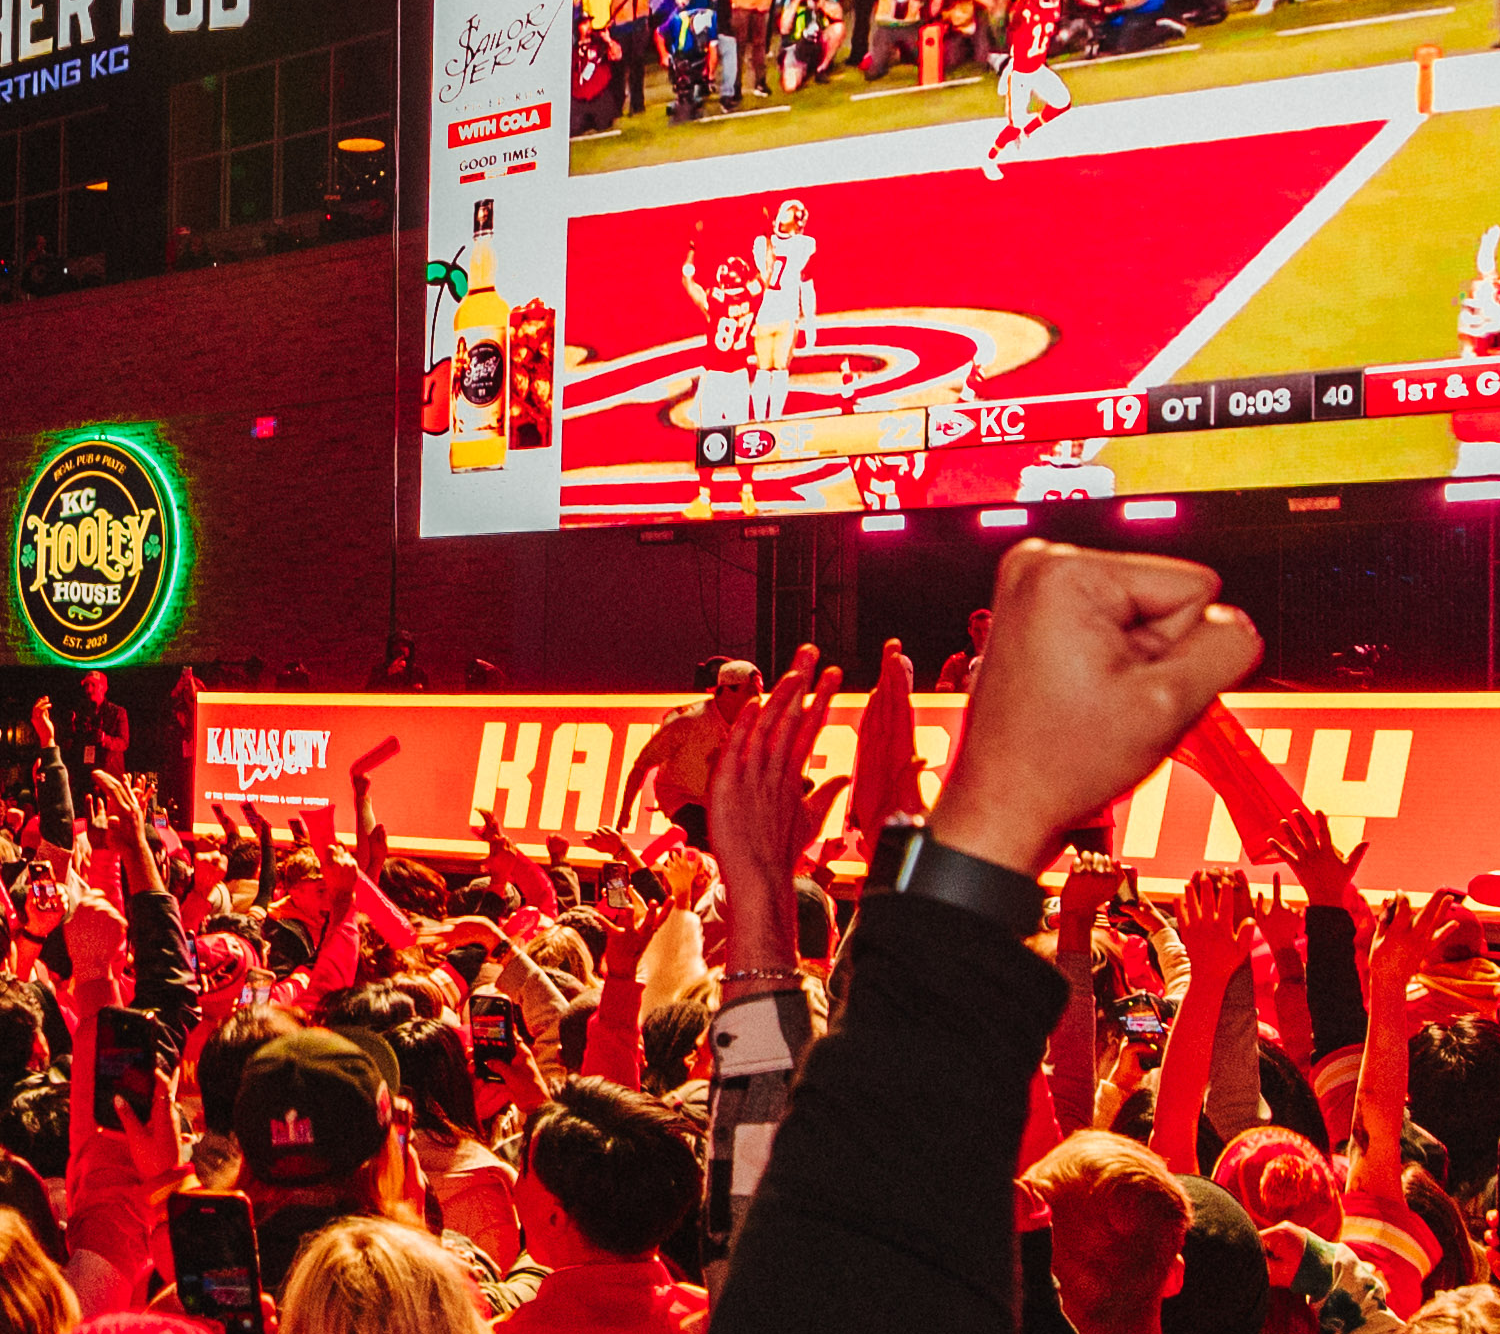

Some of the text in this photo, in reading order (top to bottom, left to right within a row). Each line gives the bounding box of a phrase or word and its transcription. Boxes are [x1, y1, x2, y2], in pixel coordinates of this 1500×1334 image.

[89, 43, 131, 80] KC
[458, 108, 541, 142] WITH COLA
[459, 155, 498, 173] GOOD
[502, 145, 538, 163] TIMES
[979, 404, 1026, 433] KC
[1096, 396, 1141, 431] 19
[1161, 396, 1202, 421] OT
[1228, 388, 1292, 416] 0:03
[1321, 384, 1354, 407] 40
[1392, 379, 1437, 403] 1ST
[1444, 374, 1470, 399] &
[59, 487, 97, 517] KC
[26, 508, 157, 592] HOOLEY
[52, 580, 122, 606] HOUSE
[85, 633, 108, 651] 2023
